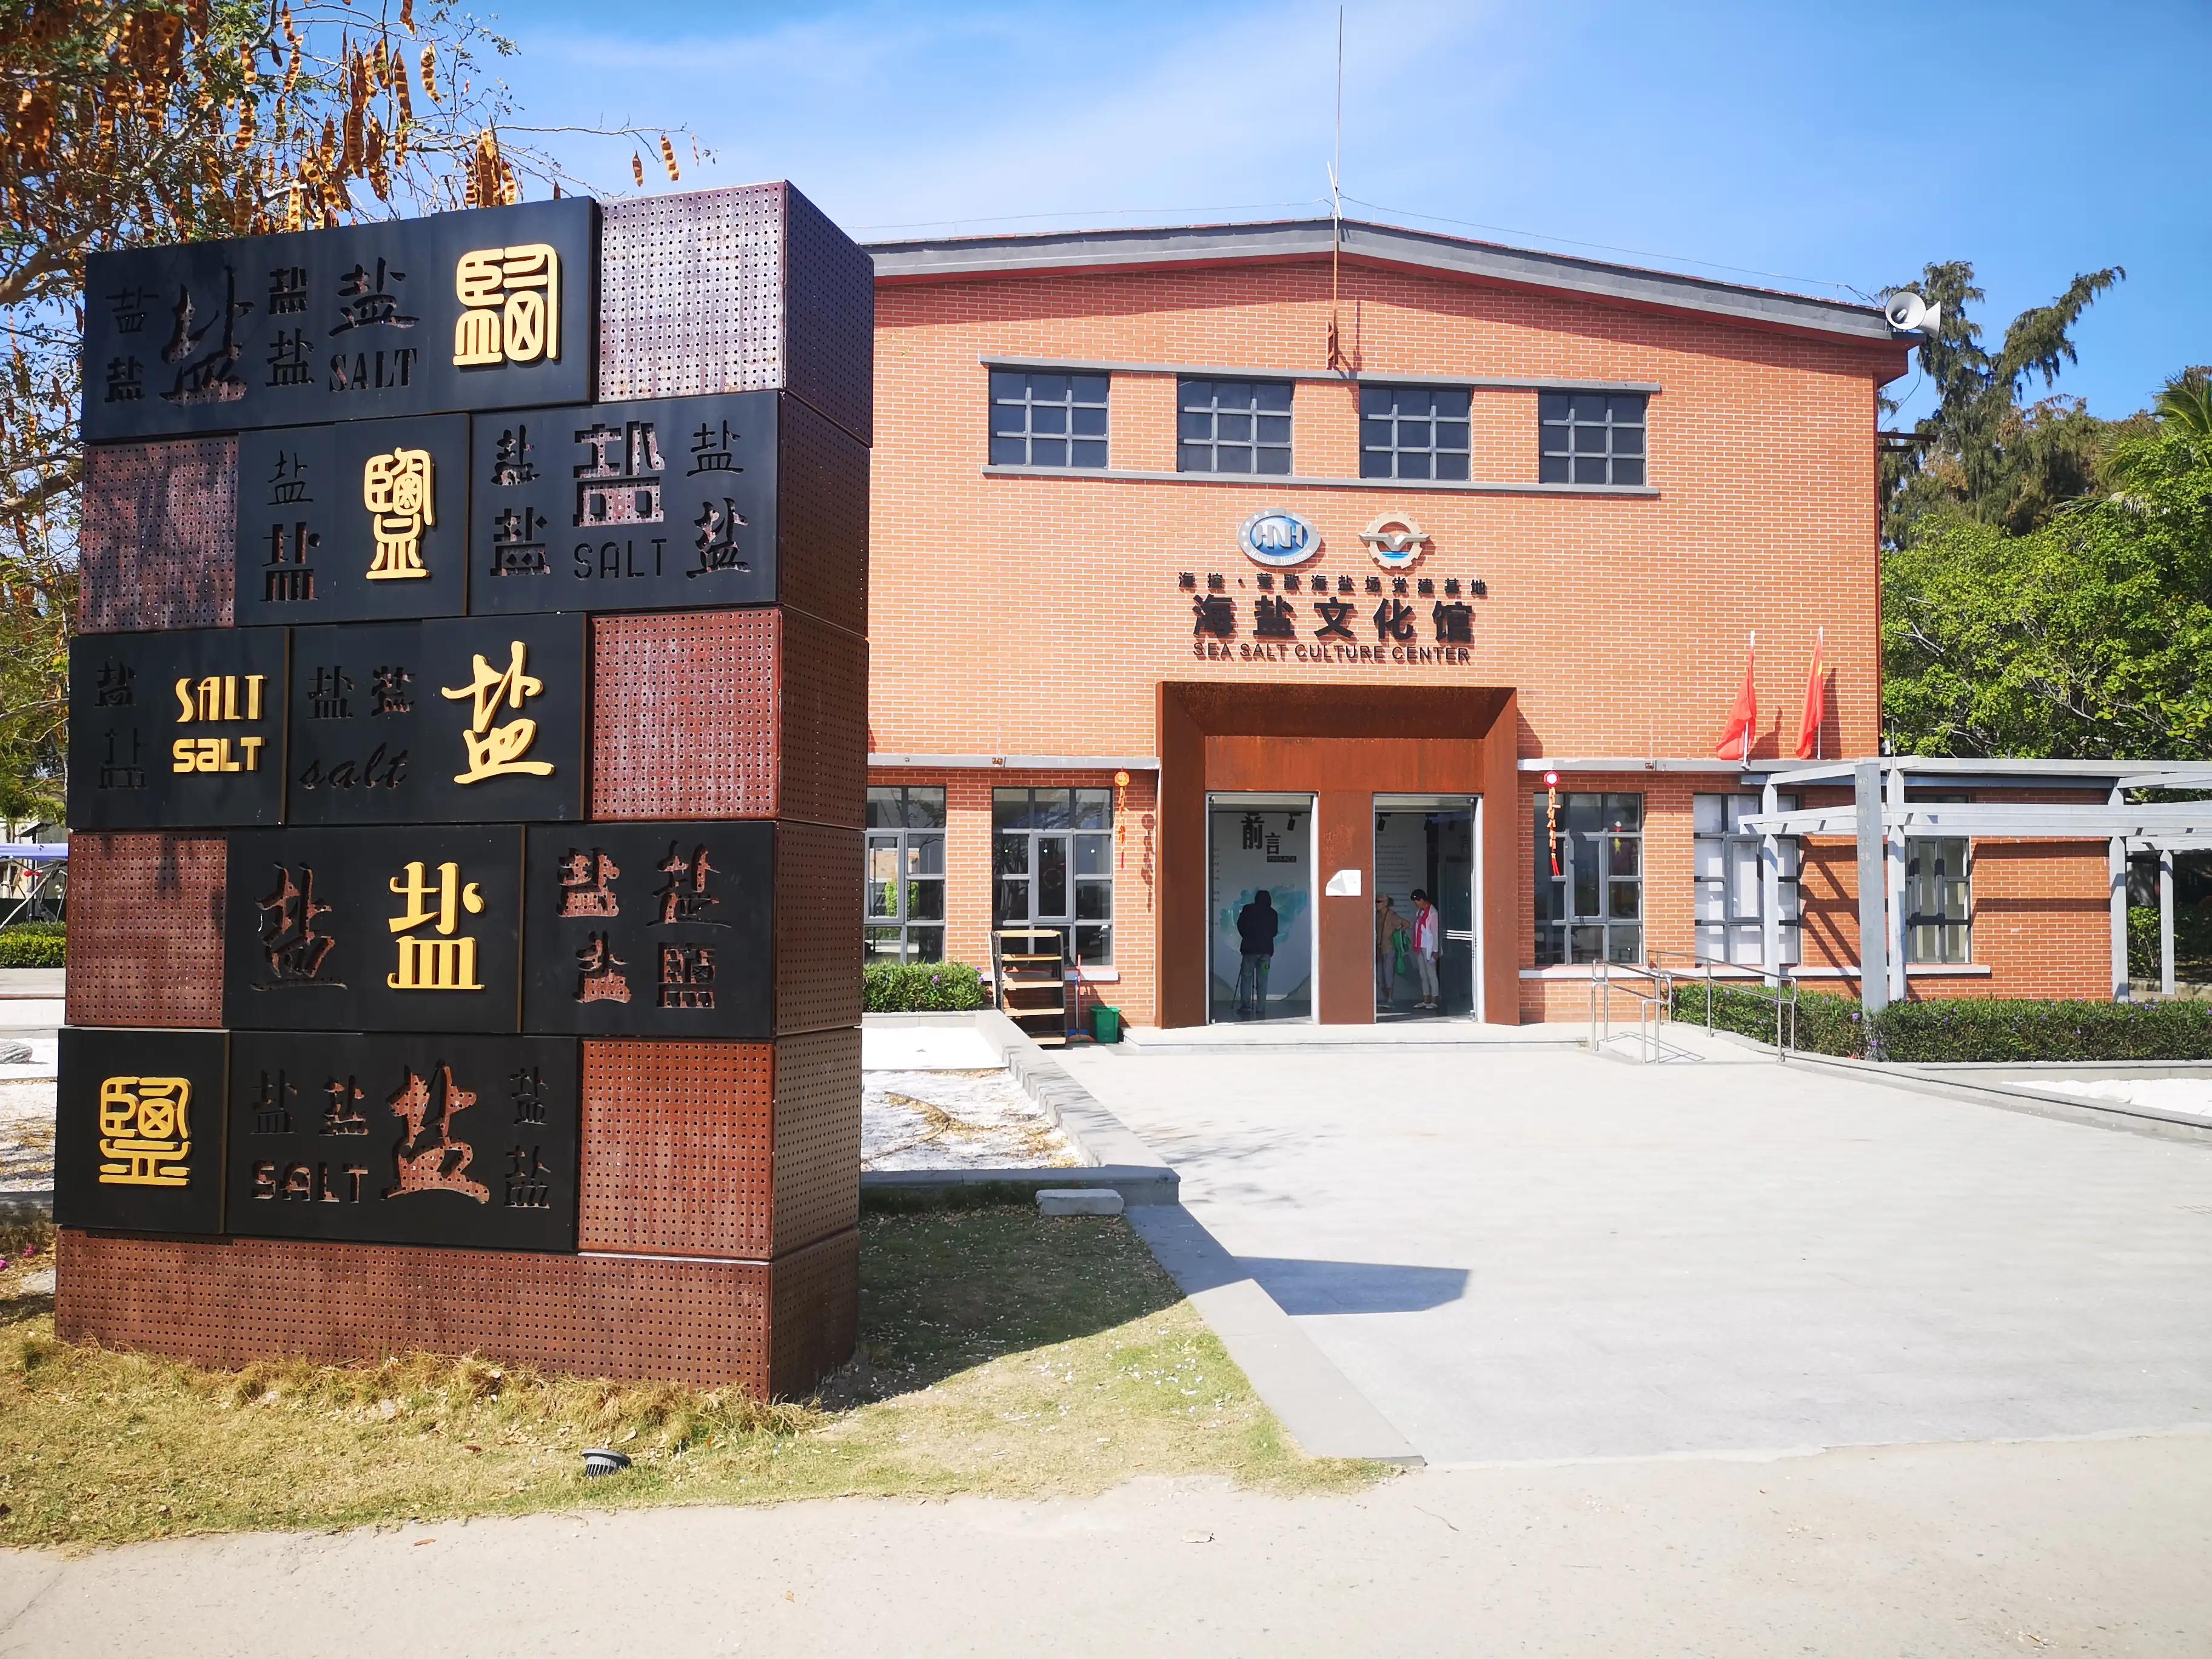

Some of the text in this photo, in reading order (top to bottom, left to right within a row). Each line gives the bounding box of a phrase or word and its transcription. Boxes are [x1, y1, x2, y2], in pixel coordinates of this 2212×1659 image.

[329, 257, 420, 337] 盐
[266, 328, 315, 387] 盐
[329, 349, 418, 394] SALT
[686, 420, 744, 477] 盐
[267, 449, 313, 506] 盐
[574, 538, 667, 579] SALT
[1193, 594, 1472, 642] 海盐文化馆
[1193, 643, 1469, 662] SEA SALT CULTURE CENTER
[176, 675, 267, 722] SALT
[307, 666, 354, 719] 盐
[441, 641, 555, 784] 盐
[299, 742, 409, 790] salt
[387, 861, 485, 990] 盐
[250, 1069, 298, 1134] 盐
[250, 1161, 369, 1204] SALT
